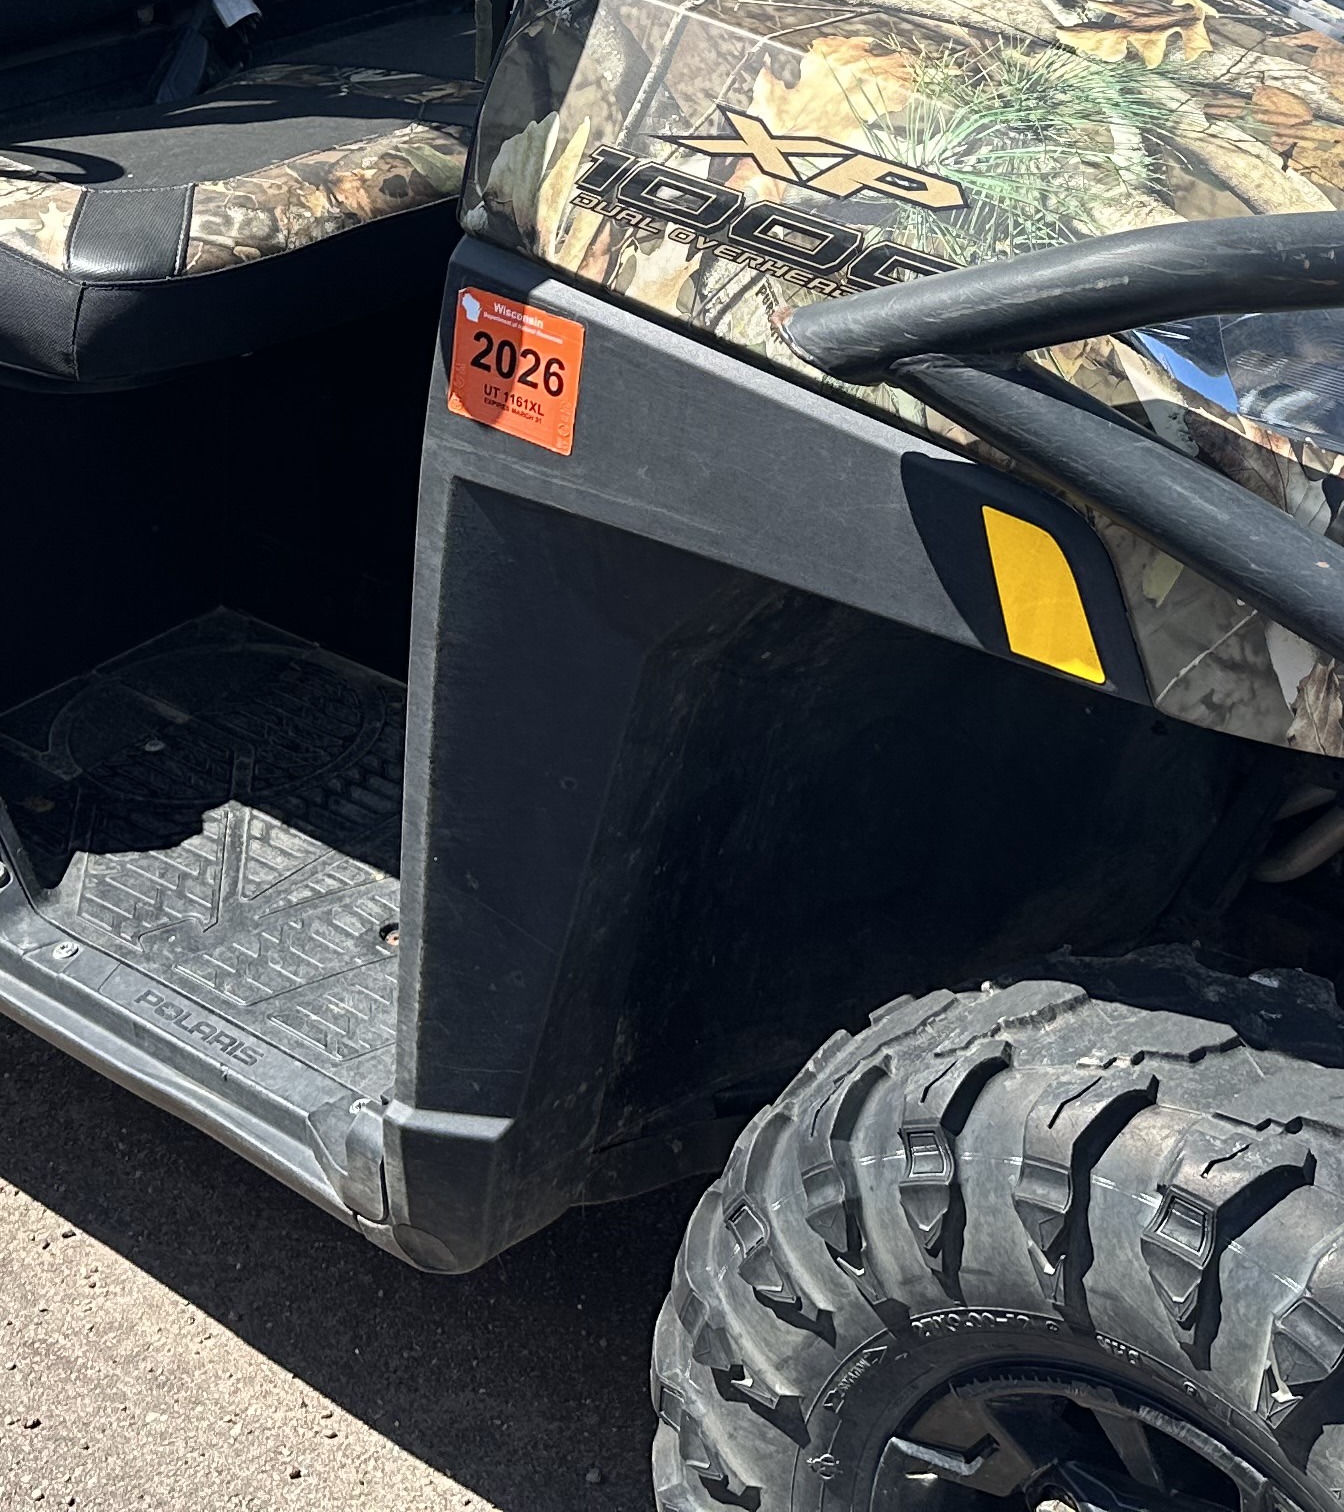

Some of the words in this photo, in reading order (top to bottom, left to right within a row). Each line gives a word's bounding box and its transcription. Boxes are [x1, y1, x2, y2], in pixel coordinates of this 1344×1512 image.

[649, 105, 970, 211] XP
[569, 191, 660, 235] DUAL
[667, 226, 863, 299] OVERHEA
[494, 301, 544, 329] Wisconsin
[470, 330, 565, 397] 2026
[484, 383, 500, 399] UT
[504, 391, 545, 417] 1161XL
[484, 397, 510, 412] EXPIRES
[511, 407, 534, 420] MARCH
[133, 988, 265, 1068] POLARIS
